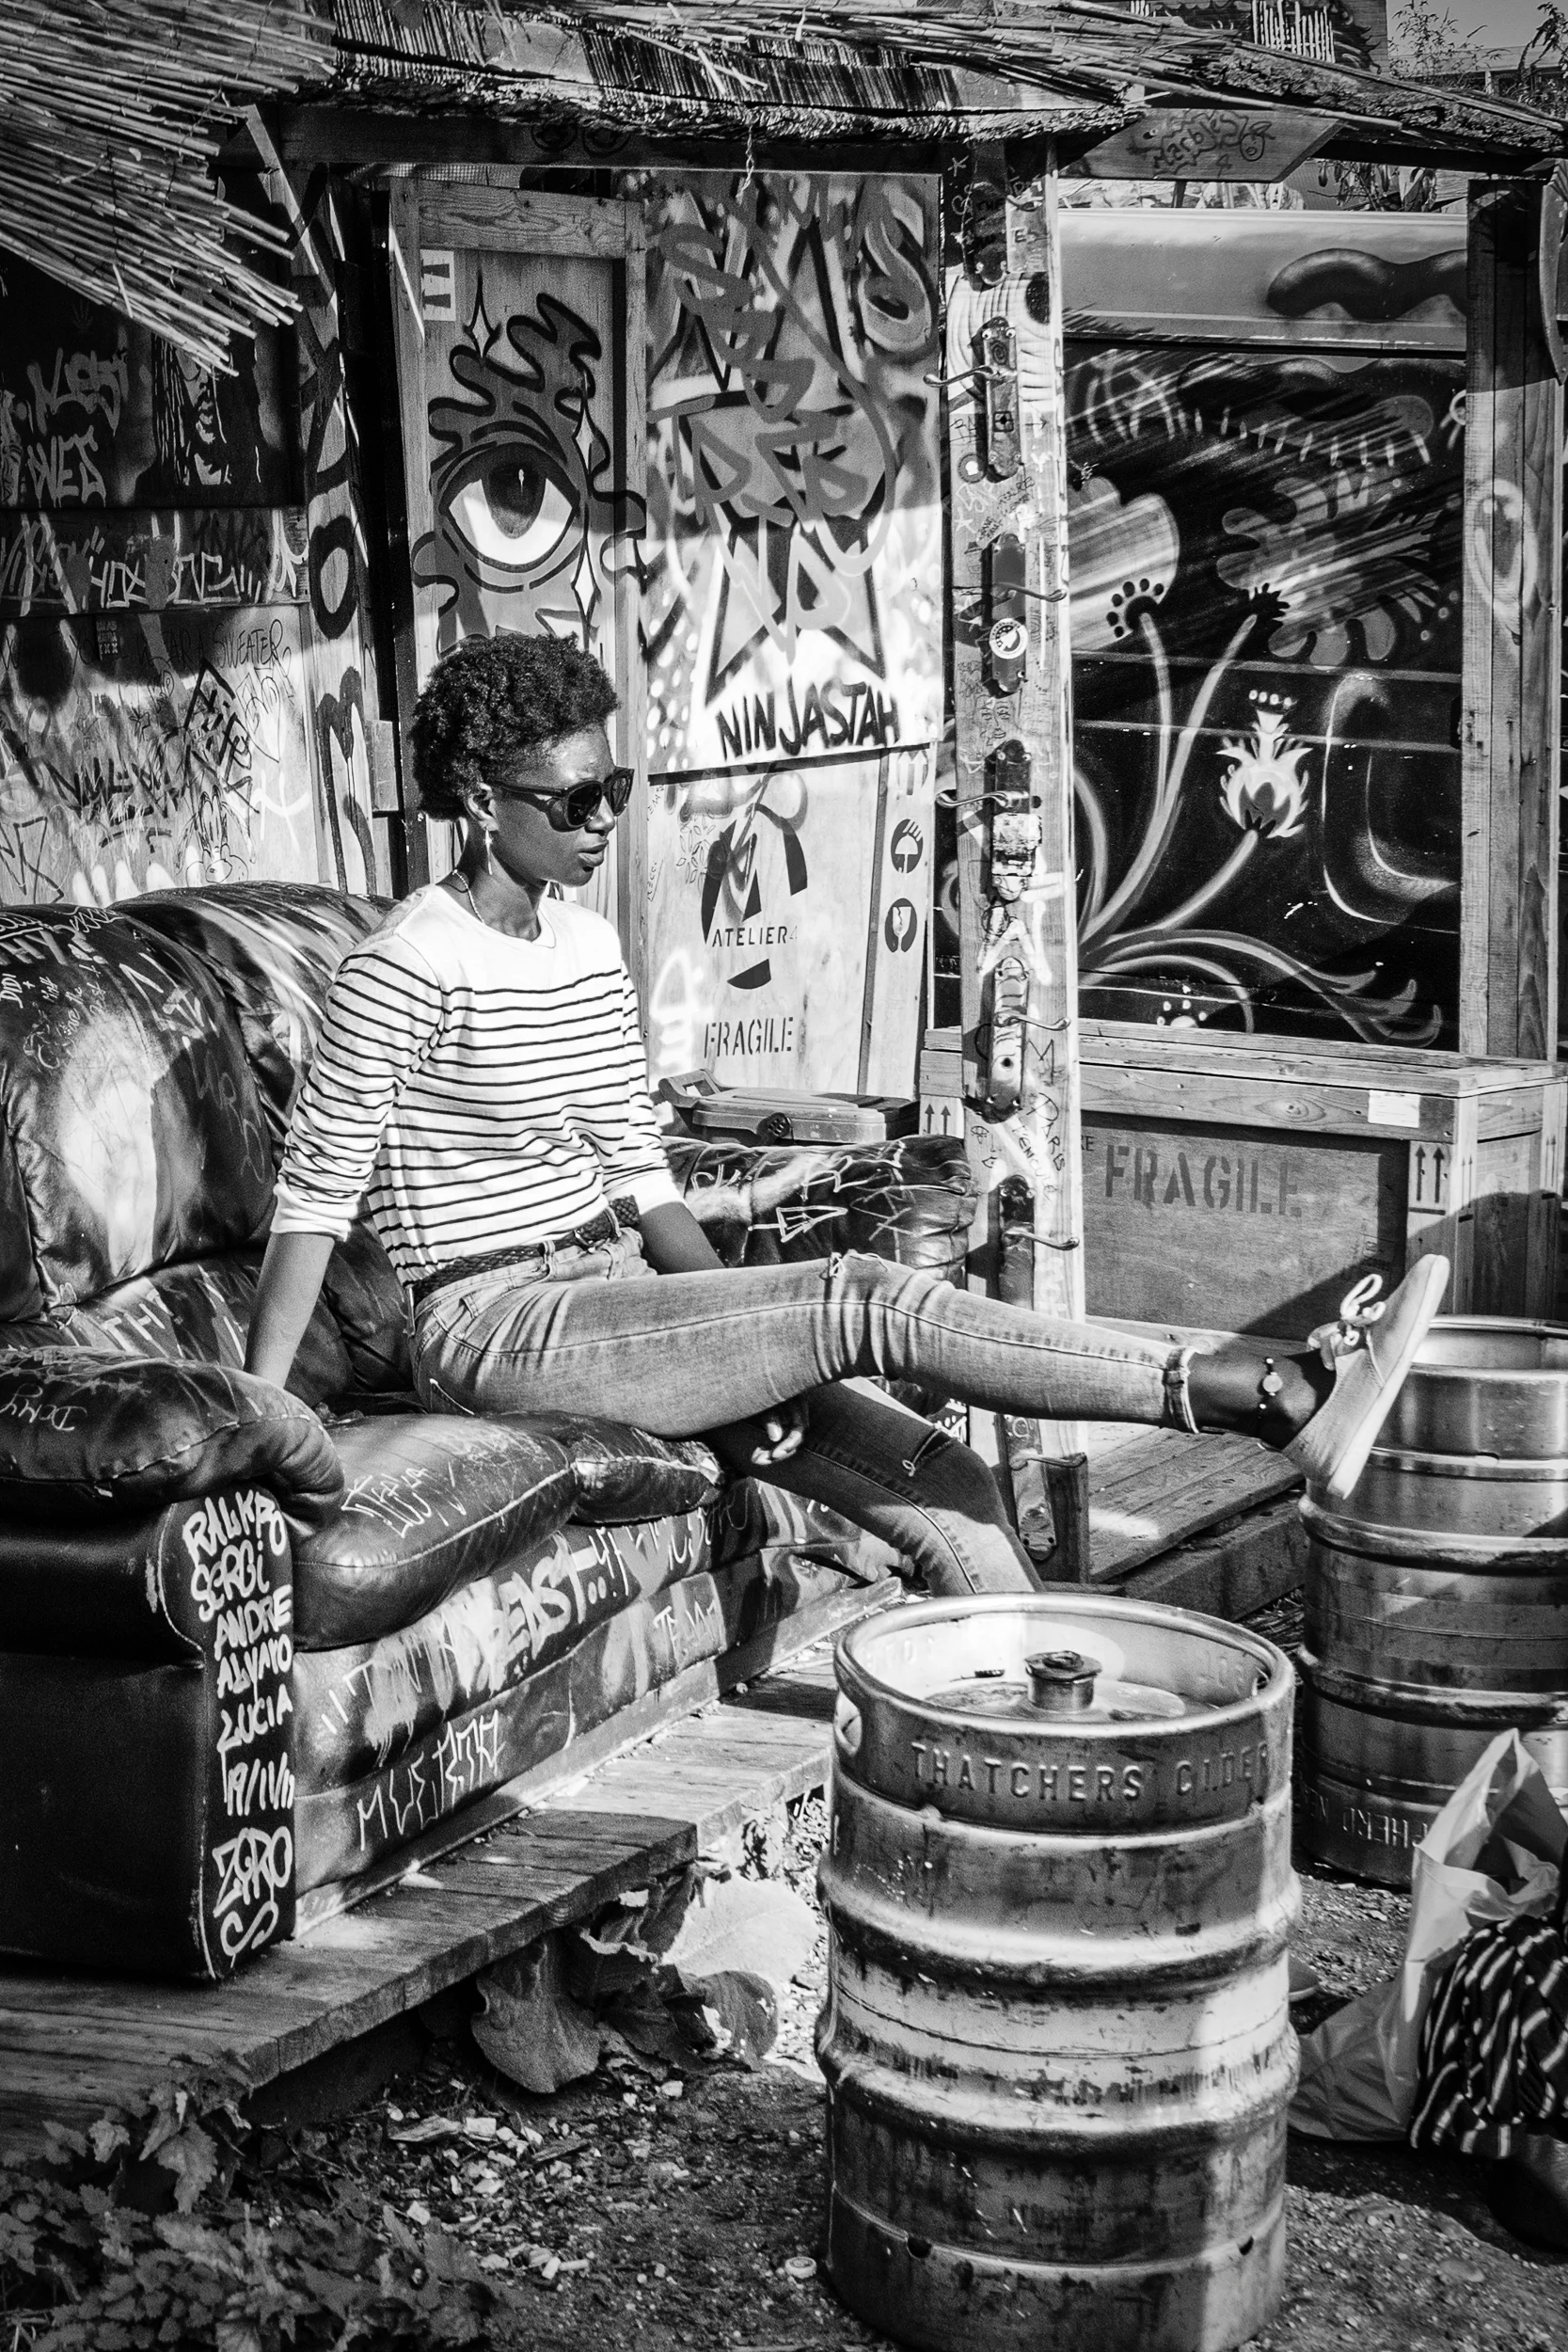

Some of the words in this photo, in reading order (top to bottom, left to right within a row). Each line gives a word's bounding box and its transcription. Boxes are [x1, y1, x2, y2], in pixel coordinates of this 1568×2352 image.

[213, 618, 284, 671] SWEATER
[716, 675, 900, 761] NINJASTAH
[704, 1016, 794, 1059] FRAGILE
[1104, 1143, 1303, 1218] FRAGILE
[214, 1584, 293, 1661] ANDRE
[911, 1740, 1144, 1803] THATCHERS
[1175, 1740, 1270, 1798] CIDER
